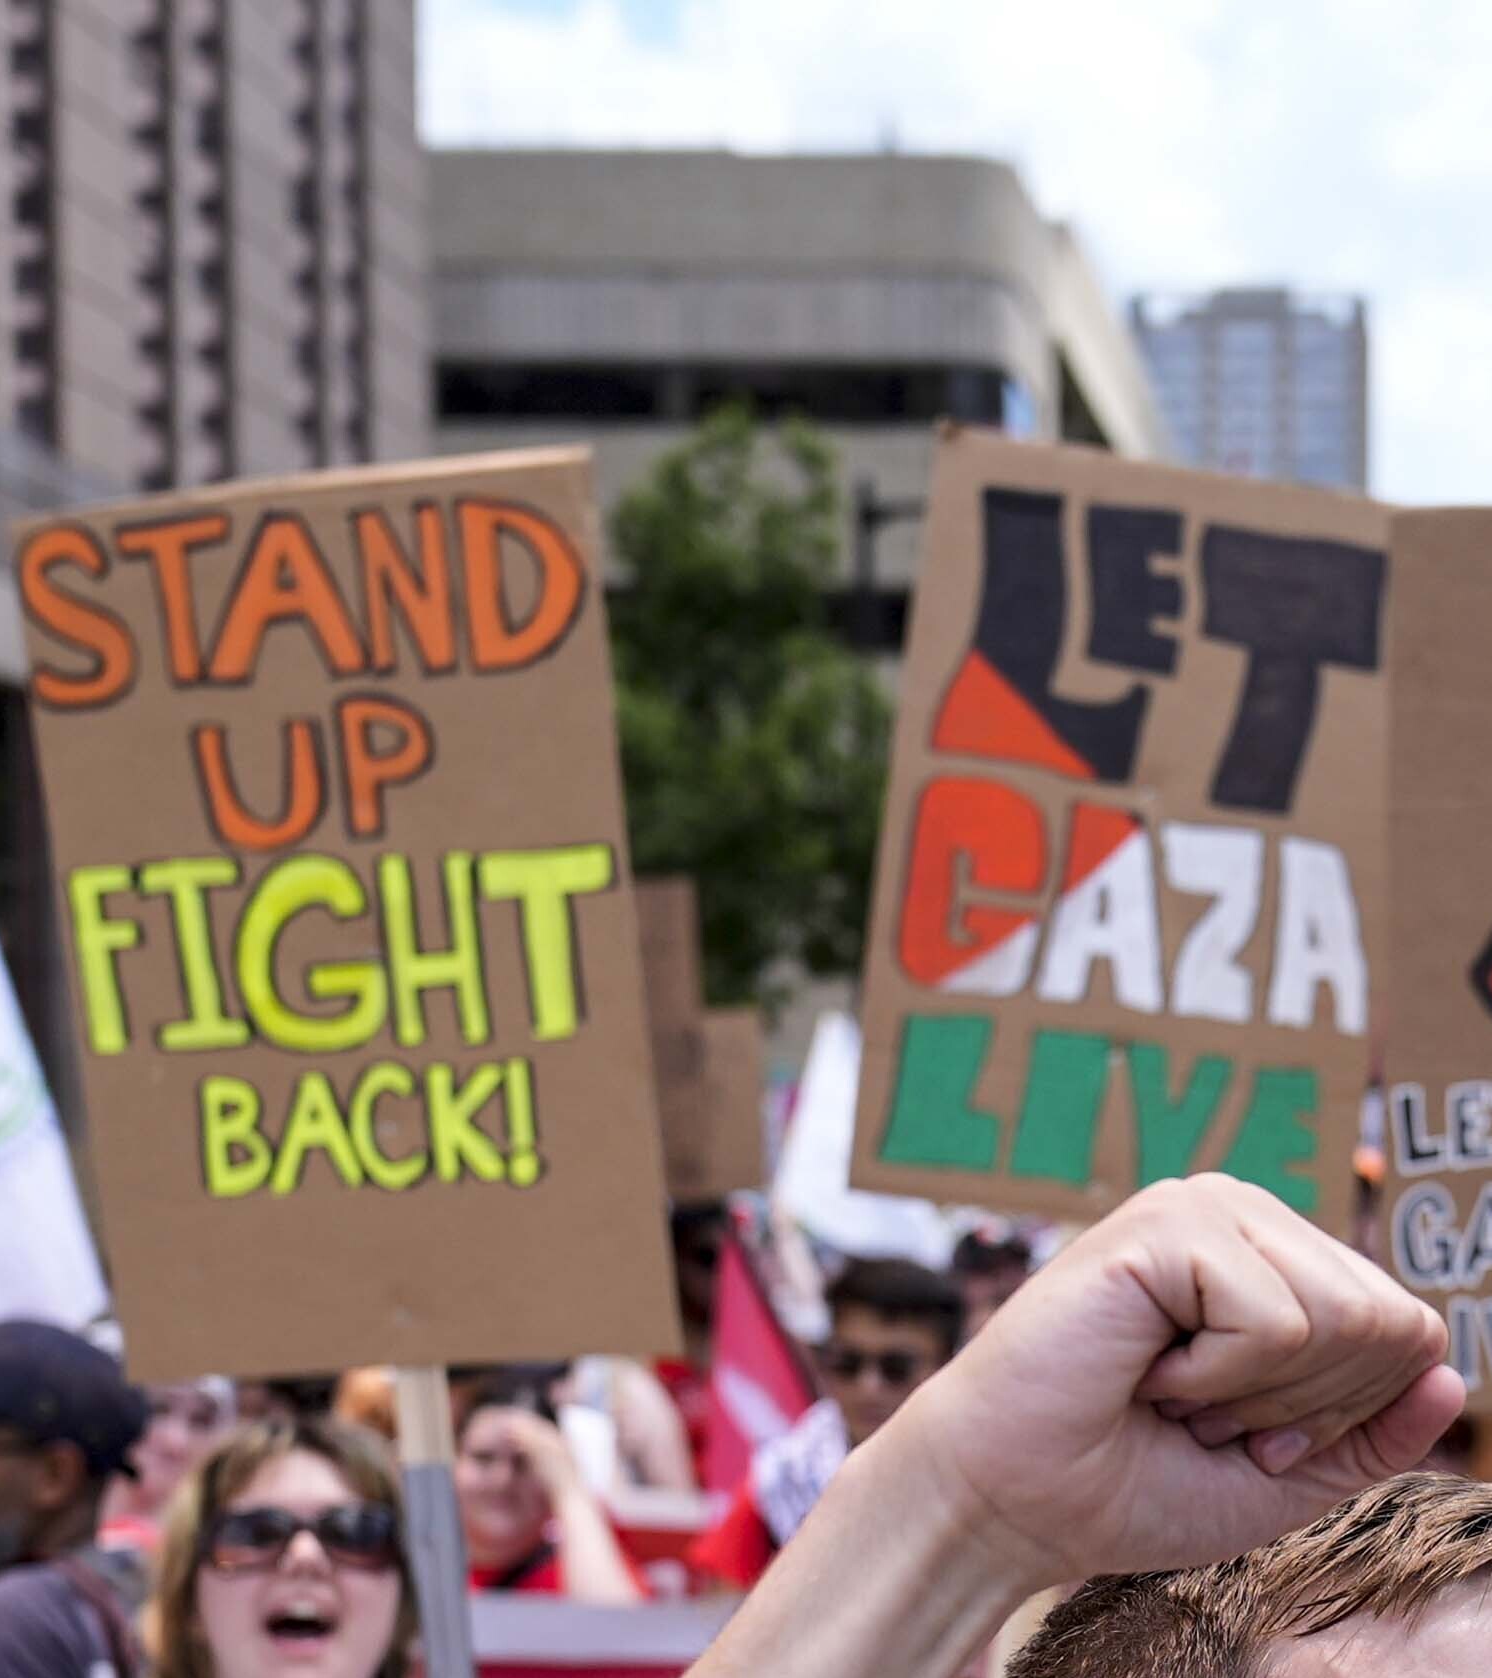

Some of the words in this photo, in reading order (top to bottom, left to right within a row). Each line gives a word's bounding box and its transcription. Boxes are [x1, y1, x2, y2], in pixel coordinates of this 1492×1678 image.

[17, 498, 586, 710] STAND
[930, 486, 1391, 814] LET
[193, 691, 439, 852] UP
[67, 841, 615, 1056] FIGHT
[899, 775, 1369, 1037] GAZA
[199, 1058, 541, 1198] BACK!
[878, 1014, 1322, 1216] LIVE
